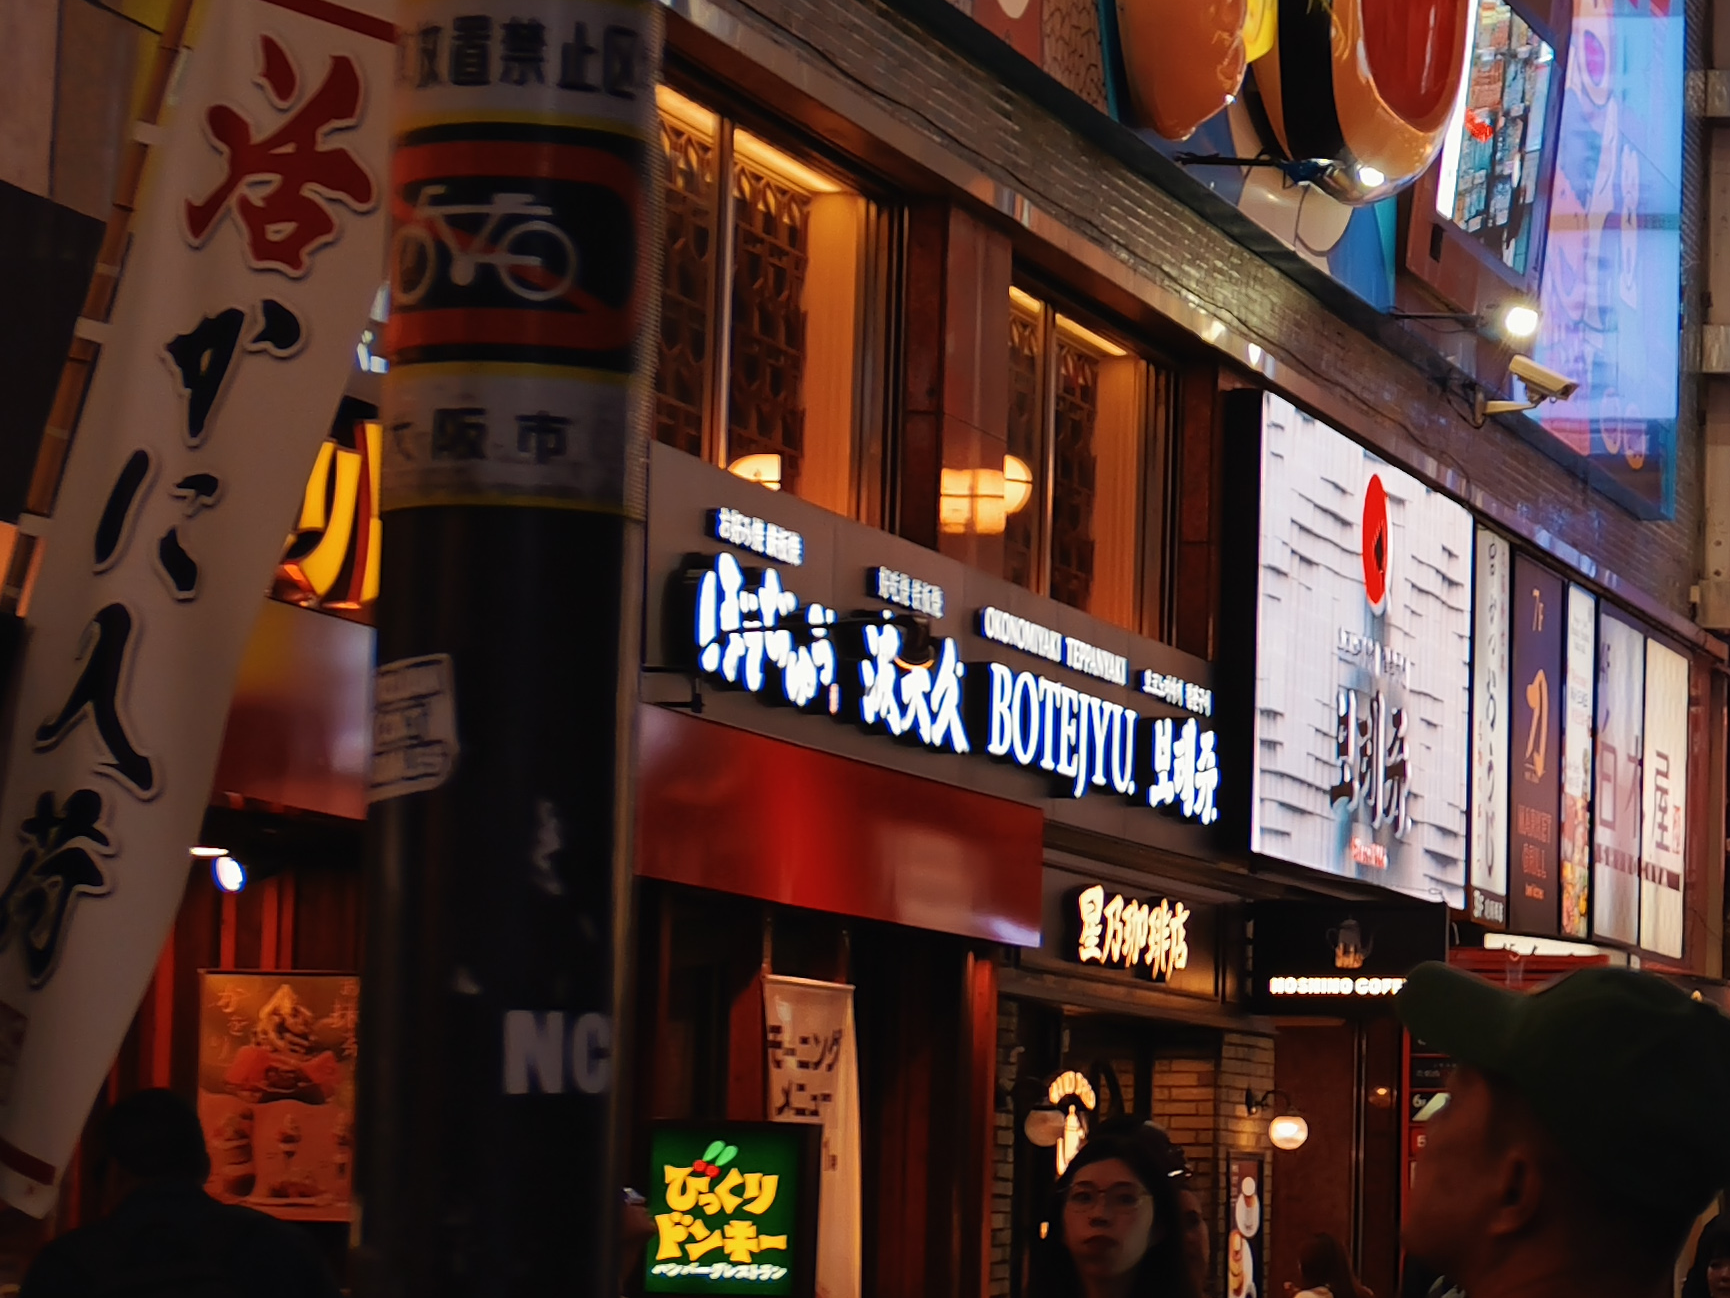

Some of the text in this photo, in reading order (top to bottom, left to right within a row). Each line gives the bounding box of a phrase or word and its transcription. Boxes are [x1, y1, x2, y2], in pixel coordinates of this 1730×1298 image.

[983, 606, 1128, 687] OKONOMIYAKI TEPPANYAKI
[1078, 885, 1190, 981] 星乃珈琲店
[1269, 976, 1353, 995] HOSHINO
[664, 1163, 779, 1215] びっくり
[655, 1212, 787, 1263] ドンキー
